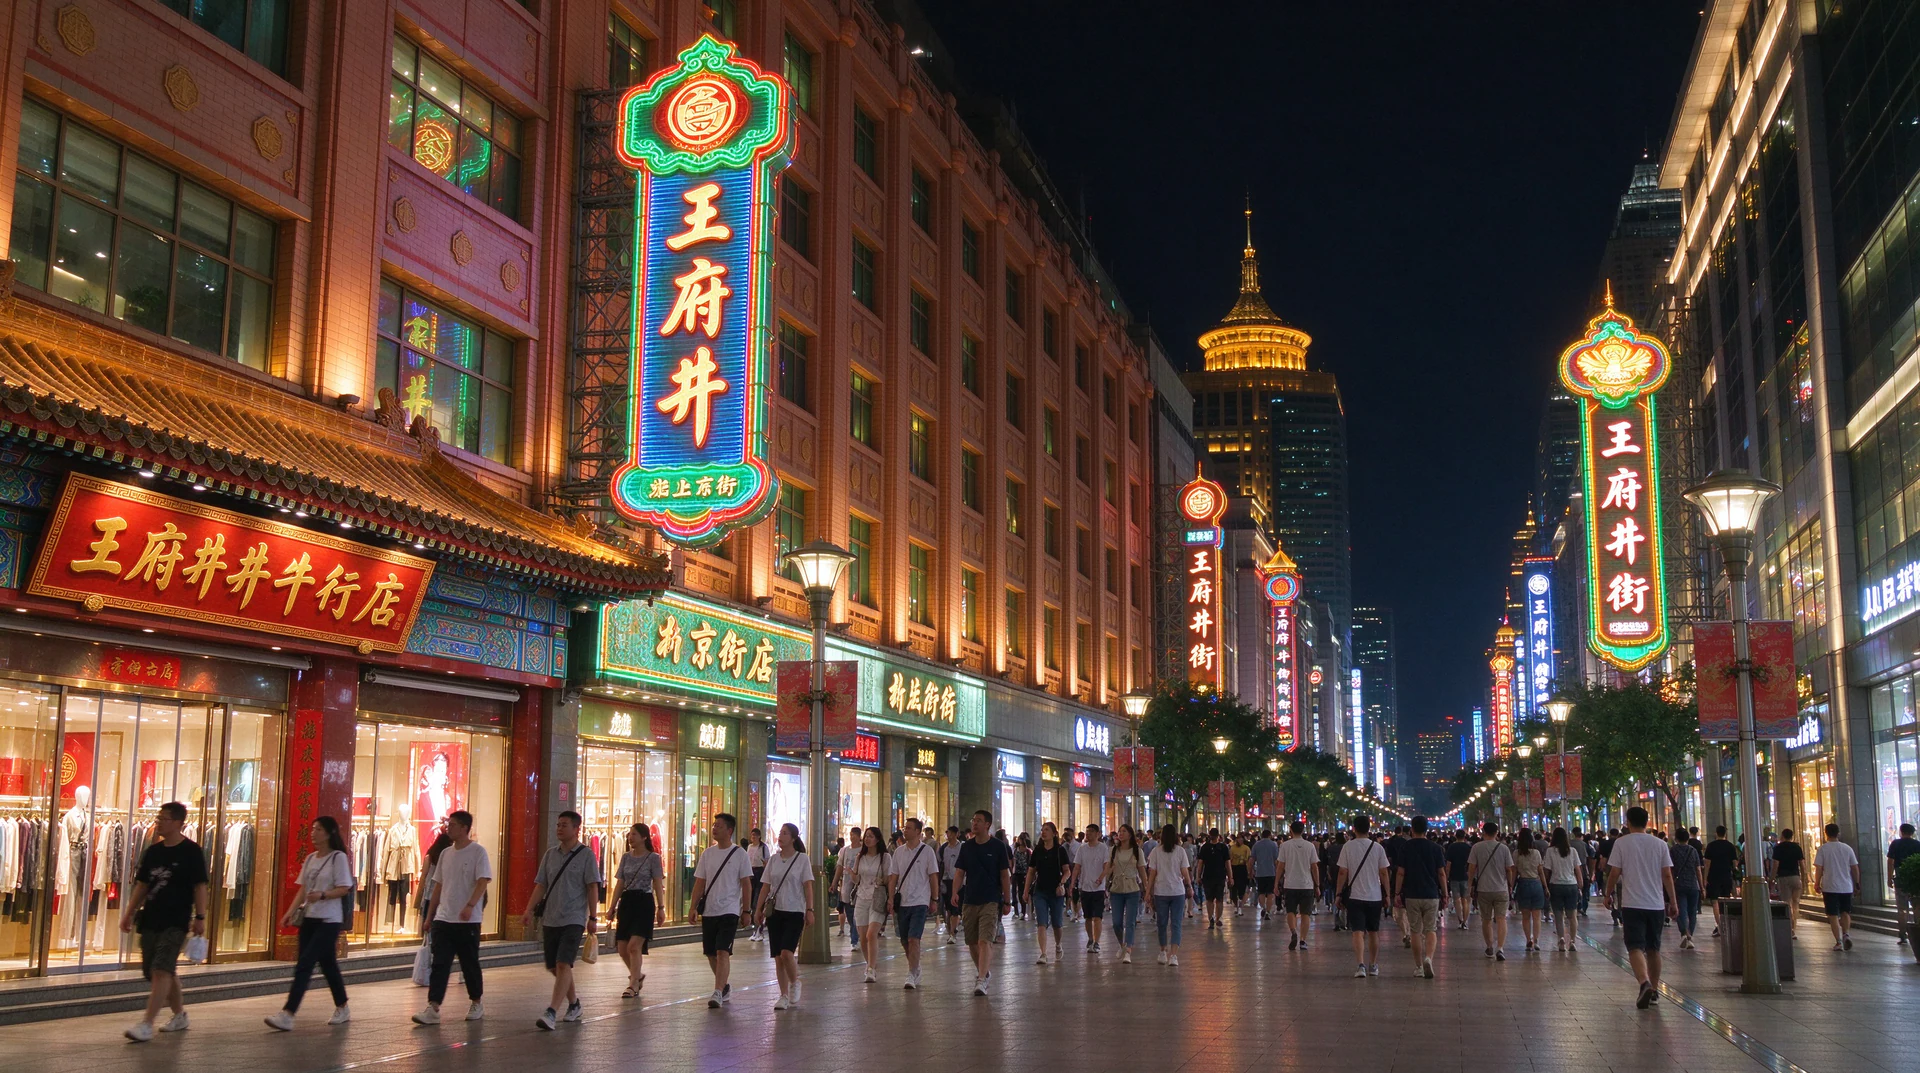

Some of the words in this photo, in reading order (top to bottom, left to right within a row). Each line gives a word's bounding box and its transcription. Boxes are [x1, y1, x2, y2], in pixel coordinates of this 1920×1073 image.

[658, 183, 732, 449] 王府井
[70, 516, 405, 628] 王府井井牛行店
[1600, 420, 1650, 614] 王府井街
[1188, 550, 1216, 671] 王府井街
